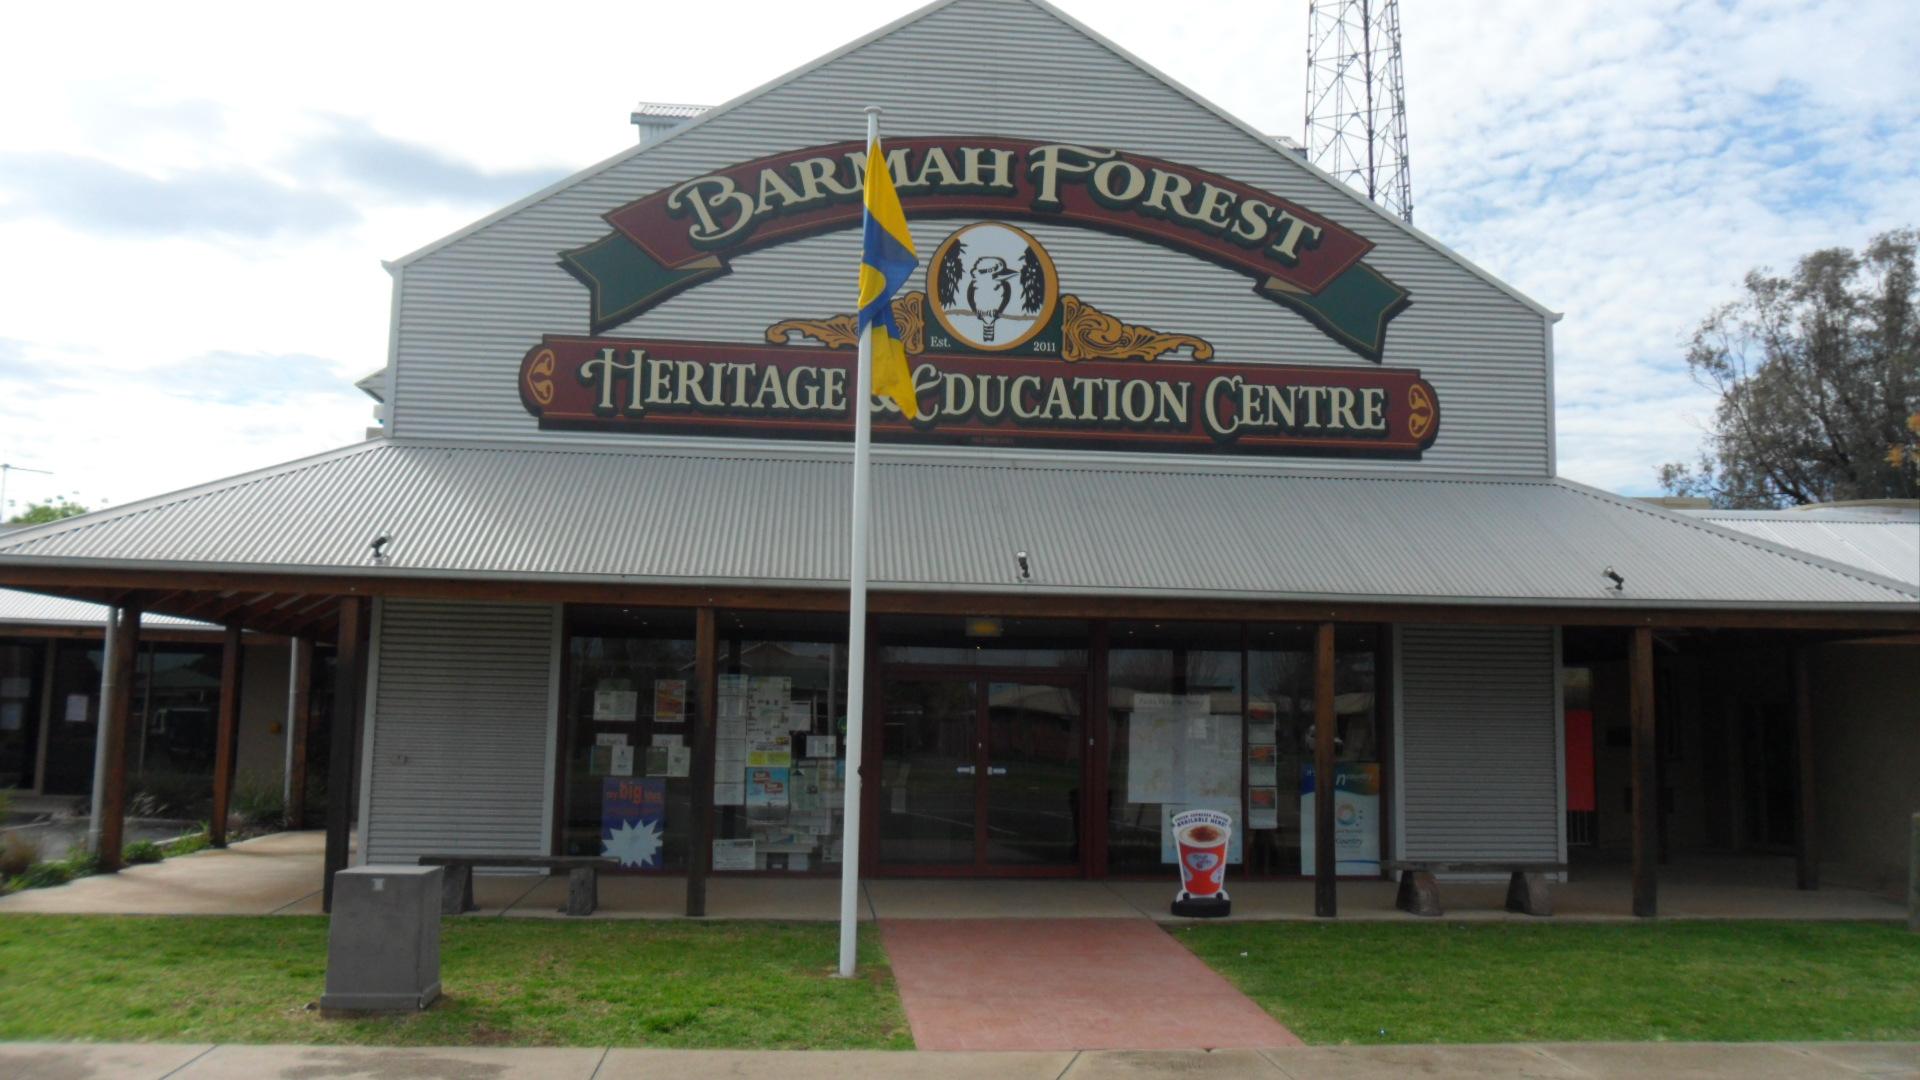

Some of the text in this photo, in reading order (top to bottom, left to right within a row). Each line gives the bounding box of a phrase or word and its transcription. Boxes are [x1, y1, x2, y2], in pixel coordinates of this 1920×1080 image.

[668, 144, 1322, 260] BARMAH FOREST
[930, 336, 1056, 352] Est. 2011
[580, 348, 847, 411] HERITAGE
[911, 363, 1386, 434] EDUCATION CENTRE
